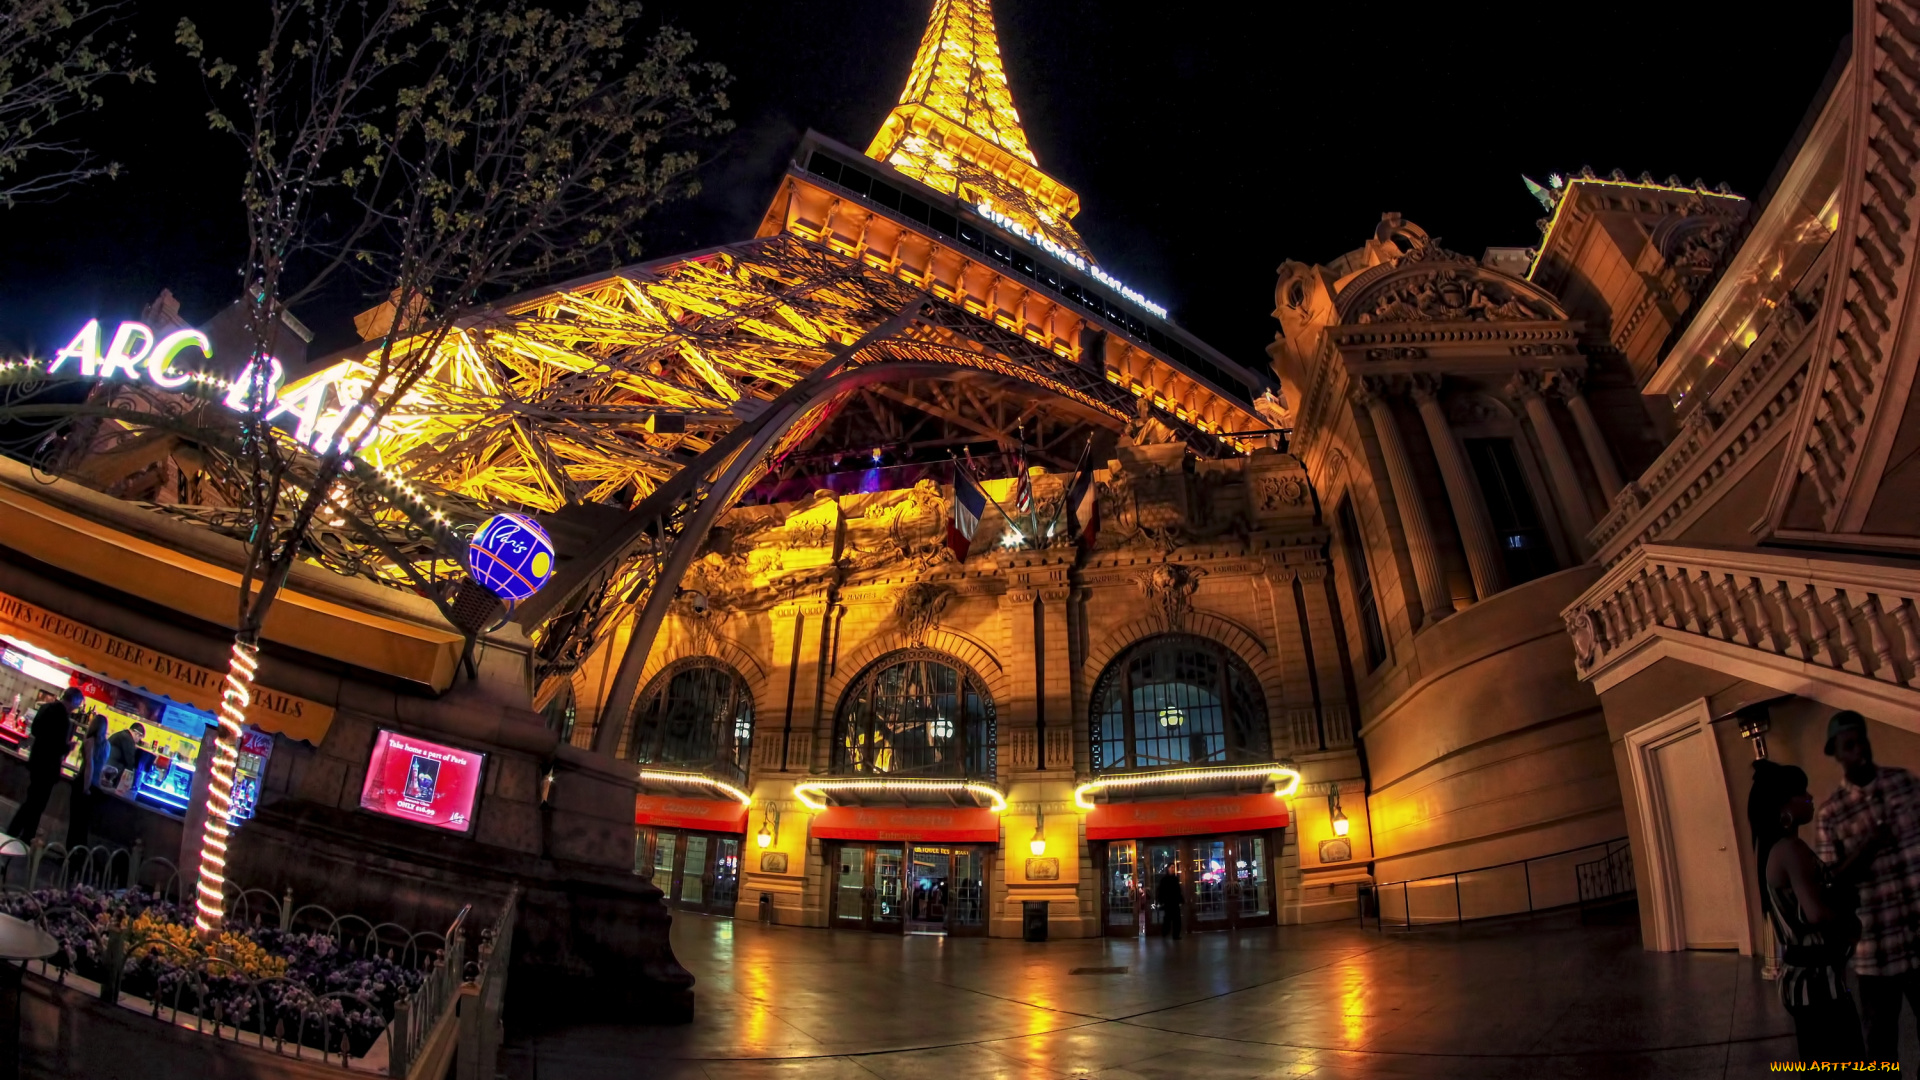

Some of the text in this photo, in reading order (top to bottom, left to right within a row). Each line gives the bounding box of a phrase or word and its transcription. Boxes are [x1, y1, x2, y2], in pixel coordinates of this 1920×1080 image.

[1033, 231, 1086, 271] TOWER
[47, 317, 213, 388] ARC
[488, 523, 528, 554] Paris
[105, 637, 146, 666] BEER
[153, 656, 210, 689] EVIAN
[389, 739, 404, 750] Take
[404, 744, 423, 755] home
[428, 751, 442, 760] part
[443, 754, 452, 762] of
[451, 755, 468, 765] Paris
[397, 800, 416, 810] ONLY
[878, 830, 922, 840] Entrance
